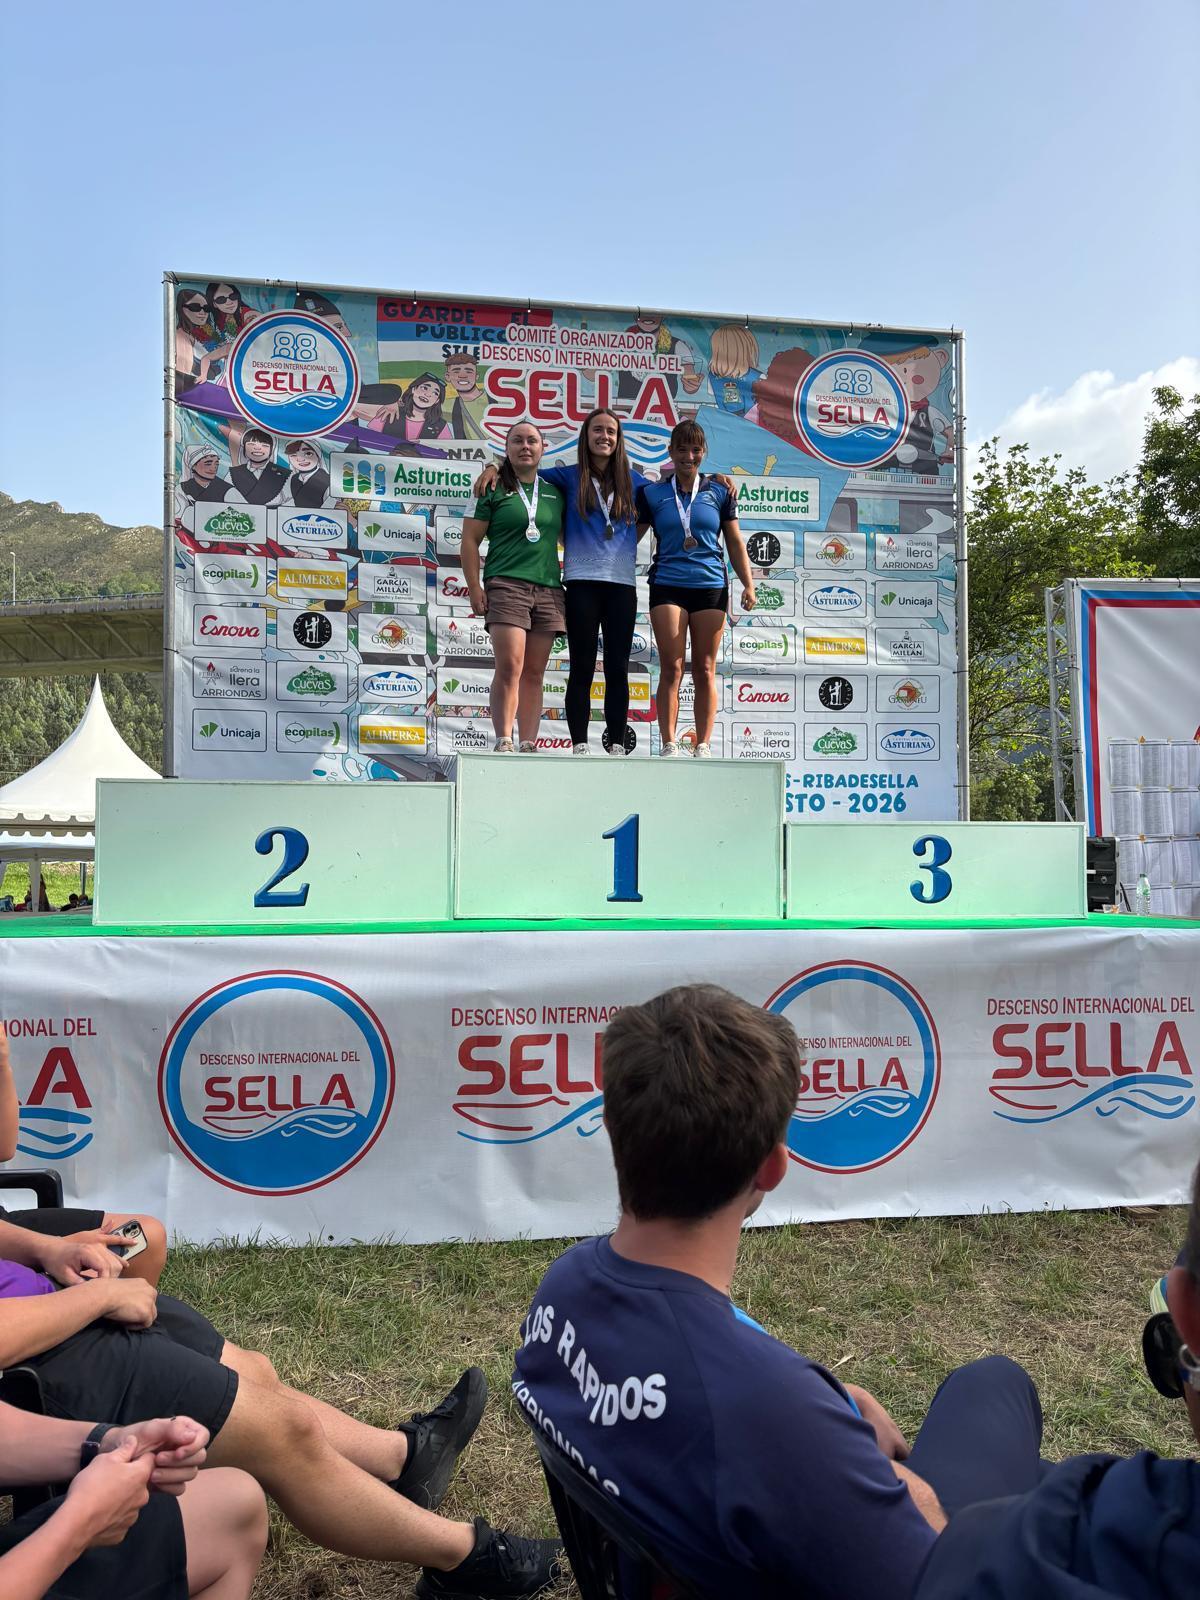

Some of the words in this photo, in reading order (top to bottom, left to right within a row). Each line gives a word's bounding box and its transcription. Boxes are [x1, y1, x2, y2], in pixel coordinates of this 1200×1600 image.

[384, 302, 476, 324] GUARDE
[416, 322, 507, 342] PÚBLICO
[508, 323, 556, 344] COMITÉ
[561, 331, 653, 350] ORGANIZADOR
[271, 331, 318, 362] 88
[442, 344, 480, 361] SILE
[482, 344, 551, 363] DESCENSO
[555, 353, 654, 370] INTERNACIONAL
[659, 357, 682, 372] DEL
[252, 360, 282, 370] DESCENSO
[283, 363, 326, 372] INTERNACIONAL
[254, 370, 337, 394] SELLA
[832, 368, 873, 396] 88
[488, 368, 677, 426] SELLA
[816, 394, 842, 403] DESCENSO
[842, 396, 880, 405] INTERNACIONAL
[882, 398, 892, 406] DEL
[818, 404, 890, 426] SELLA
[448, 448, 486, 460] NTA
[394, 463, 472, 487] Asturias
[394, 485, 432, 497] paraíso
[435, 488, 472, 498] natural
[738, 482, 809, 503] Asturias
[738, 499, 773, 513] paraíso
[775, 504, 809, 514] natural
[287, 522, 338, 536] ASTURIANA
[384, 529, 422, 542] Unicaja
[906, 547, 933, 558] llera
[202, 568, 252, 581] ecopilas
[284, 574, 342, 586] ALIMERKA
[442, 576, 470, 597] Esn
[812, 595, 858, 606] ASTURIANA
[898, 596, 933, 608] Unicaja
[200, 614, 260, 638] Esnova
[470, 632, 490, 645] ller
[740, 638, 783, 651] ecopilas
[444, 647, 494, 656] ARRIONDA
[810, 641, 861, 652] ALIMERKA
[230, 674, 260, 686] llera
[367, 681, 418, 692] ASTURIANA
[201, 688, 262, 698] ARRIONDAS
[462, 684, 490, 694] Unica
[738, 683, 790, 704] Esnova
[220, 728, 261, 740] Unicaja
[284, 728, 334, 740] ecopilas
[364, 729, 420, 742] ALIMERKA
[454, 732, 486, 740] GARCÍA
[454, 740, 486, 748] MILLÁN
[534, 737, 572, 749] nova
[764, 736, 790, 748] llera
[886, 738, 931, 750] ASTURIANA
[786, 773, 919, 789] S-RIBADESELLA
[786, 792, 826, 813] STO
[848, 792, 907, 813] 2026
[602, 814, 644, 903] 1
[254, 826, 310, 908] 2
[910, 834, 953, 904] 3
[987, 998, 1058, 1016] DESCENSO
[1062, 996, 1167, 1014] INTERNACIONAL
[1170, 996, 1195, 1012] DEL
[452, 1007, 536, 1028] DESCENSO
[64, 1018, 97, 1036] DEL
[829, 1036, 894, 1048] INTERNACIONAL
[896, 1036, 912, 1047] DEL
[992, 1020, 1194, 1080] SELLA
[200, 1052, 254, 1066] DESCENSO
[258, 1052, 337, 1065] INTERNACIONAL
[341, 1050, 360, 1062] DEL
[204, 1073, 356, 1112] SELLA
[524, 1304, 555, 1348] LOS
[556, 1320, 667, 1426] RAPIDOS
